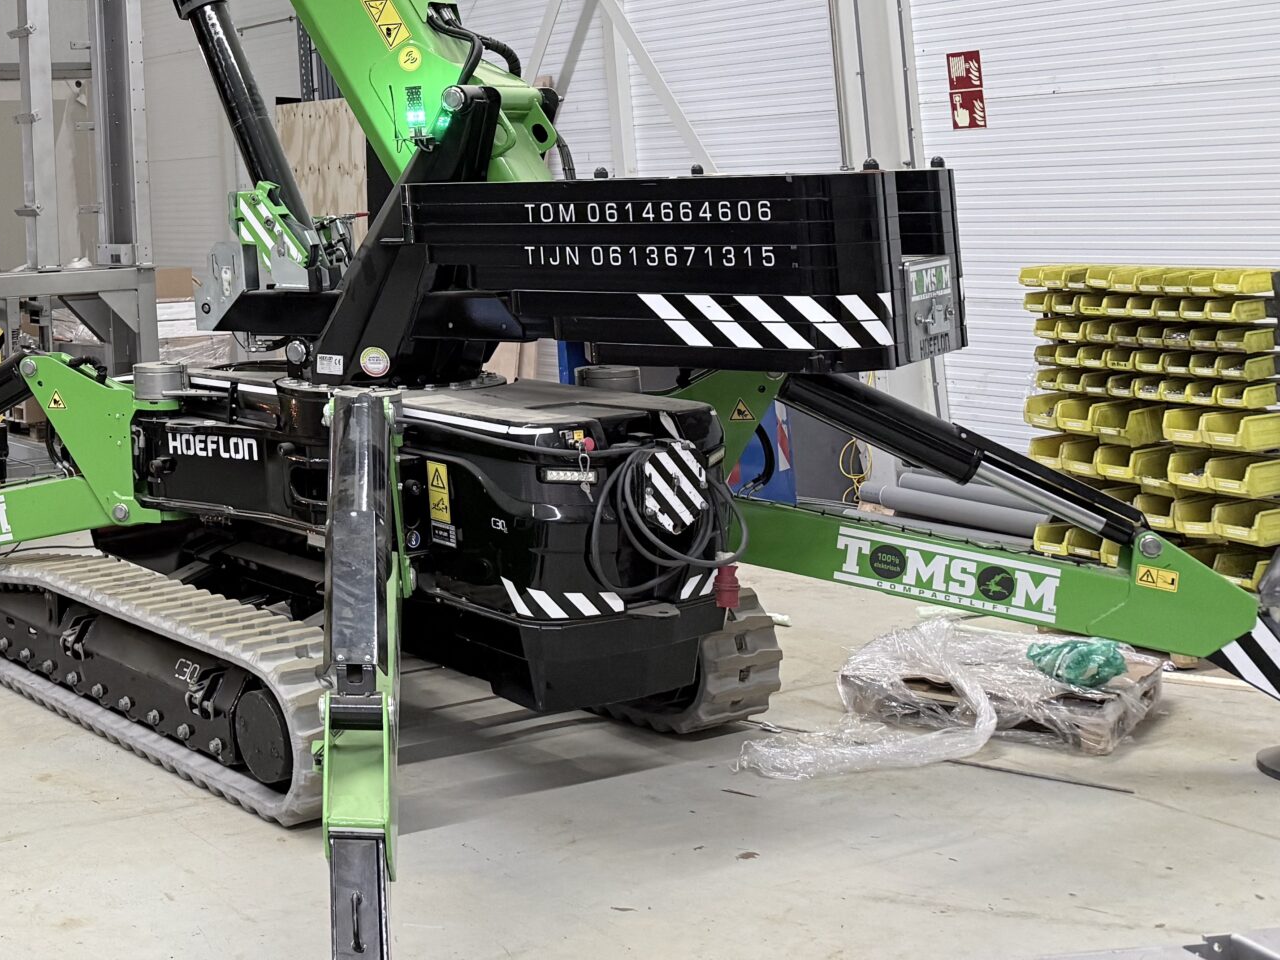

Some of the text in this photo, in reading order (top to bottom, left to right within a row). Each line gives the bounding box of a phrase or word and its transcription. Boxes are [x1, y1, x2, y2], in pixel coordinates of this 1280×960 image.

[524, 201, 771, 223] TOM 0614664606
[524, 246, 776, 267] TIJN 0613671315
[168, 432, 259, 461] HOEFLON
[877, 552, 900, 565] 100%
[836, 535, 1060, 614] TOMSOM
[876, 580, 1011, 613] COMPACTLIFT
